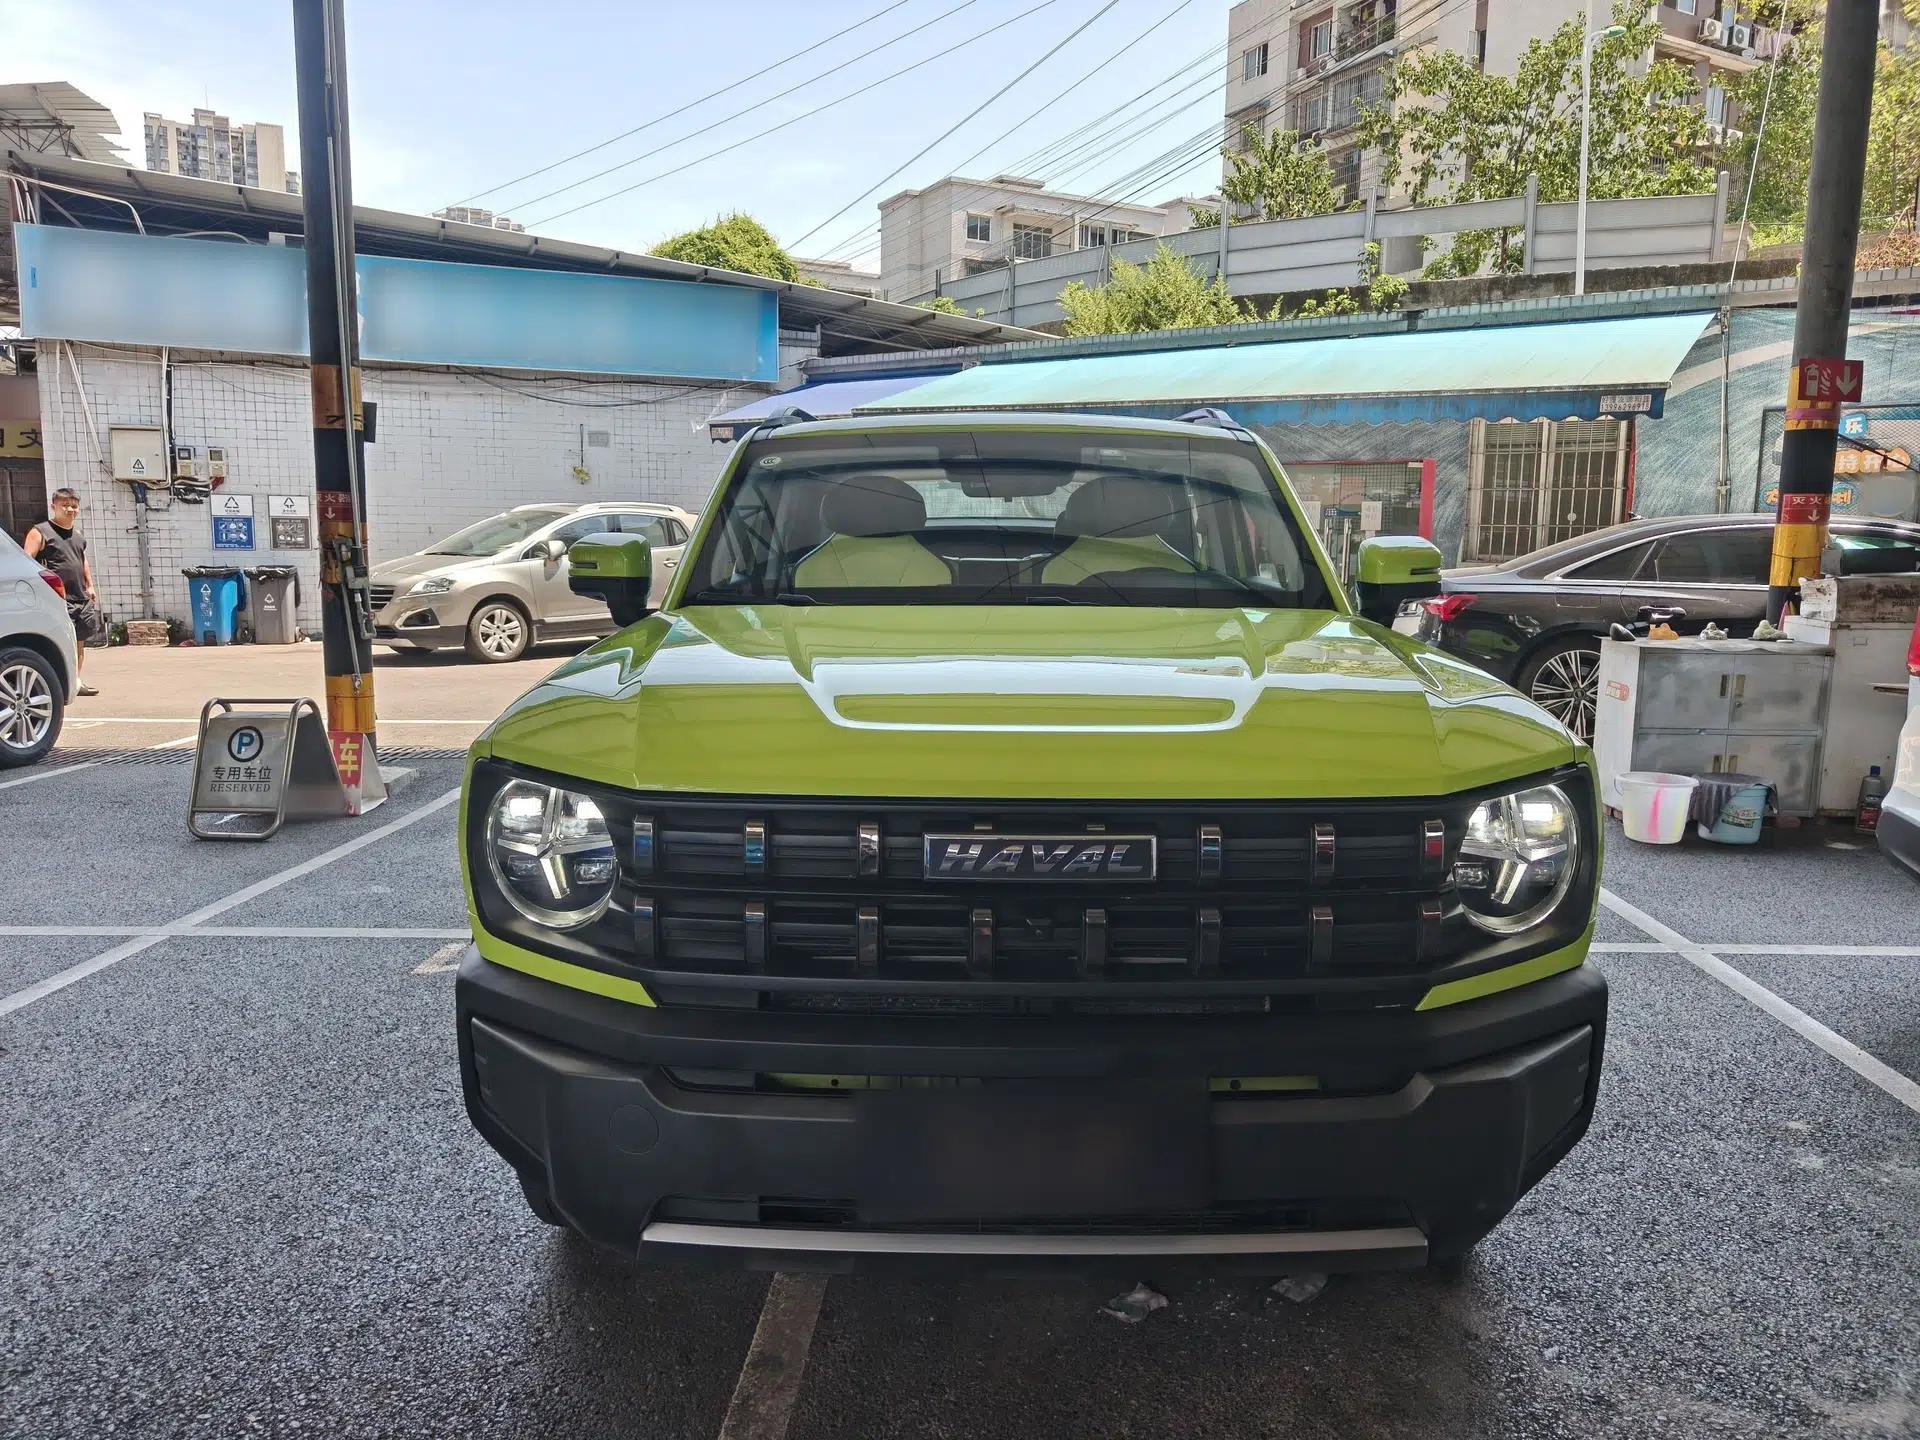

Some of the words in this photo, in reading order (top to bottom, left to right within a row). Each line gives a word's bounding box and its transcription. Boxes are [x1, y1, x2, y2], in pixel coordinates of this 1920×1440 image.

[1792, 496, 1832, 505] 灭火
[237, 732, 255, 755] P
[212, 766, 272, 780] 专用车位
[210, 783, 271, 793] RESERVED
[939, 844, 1143, 872] HAVAL
